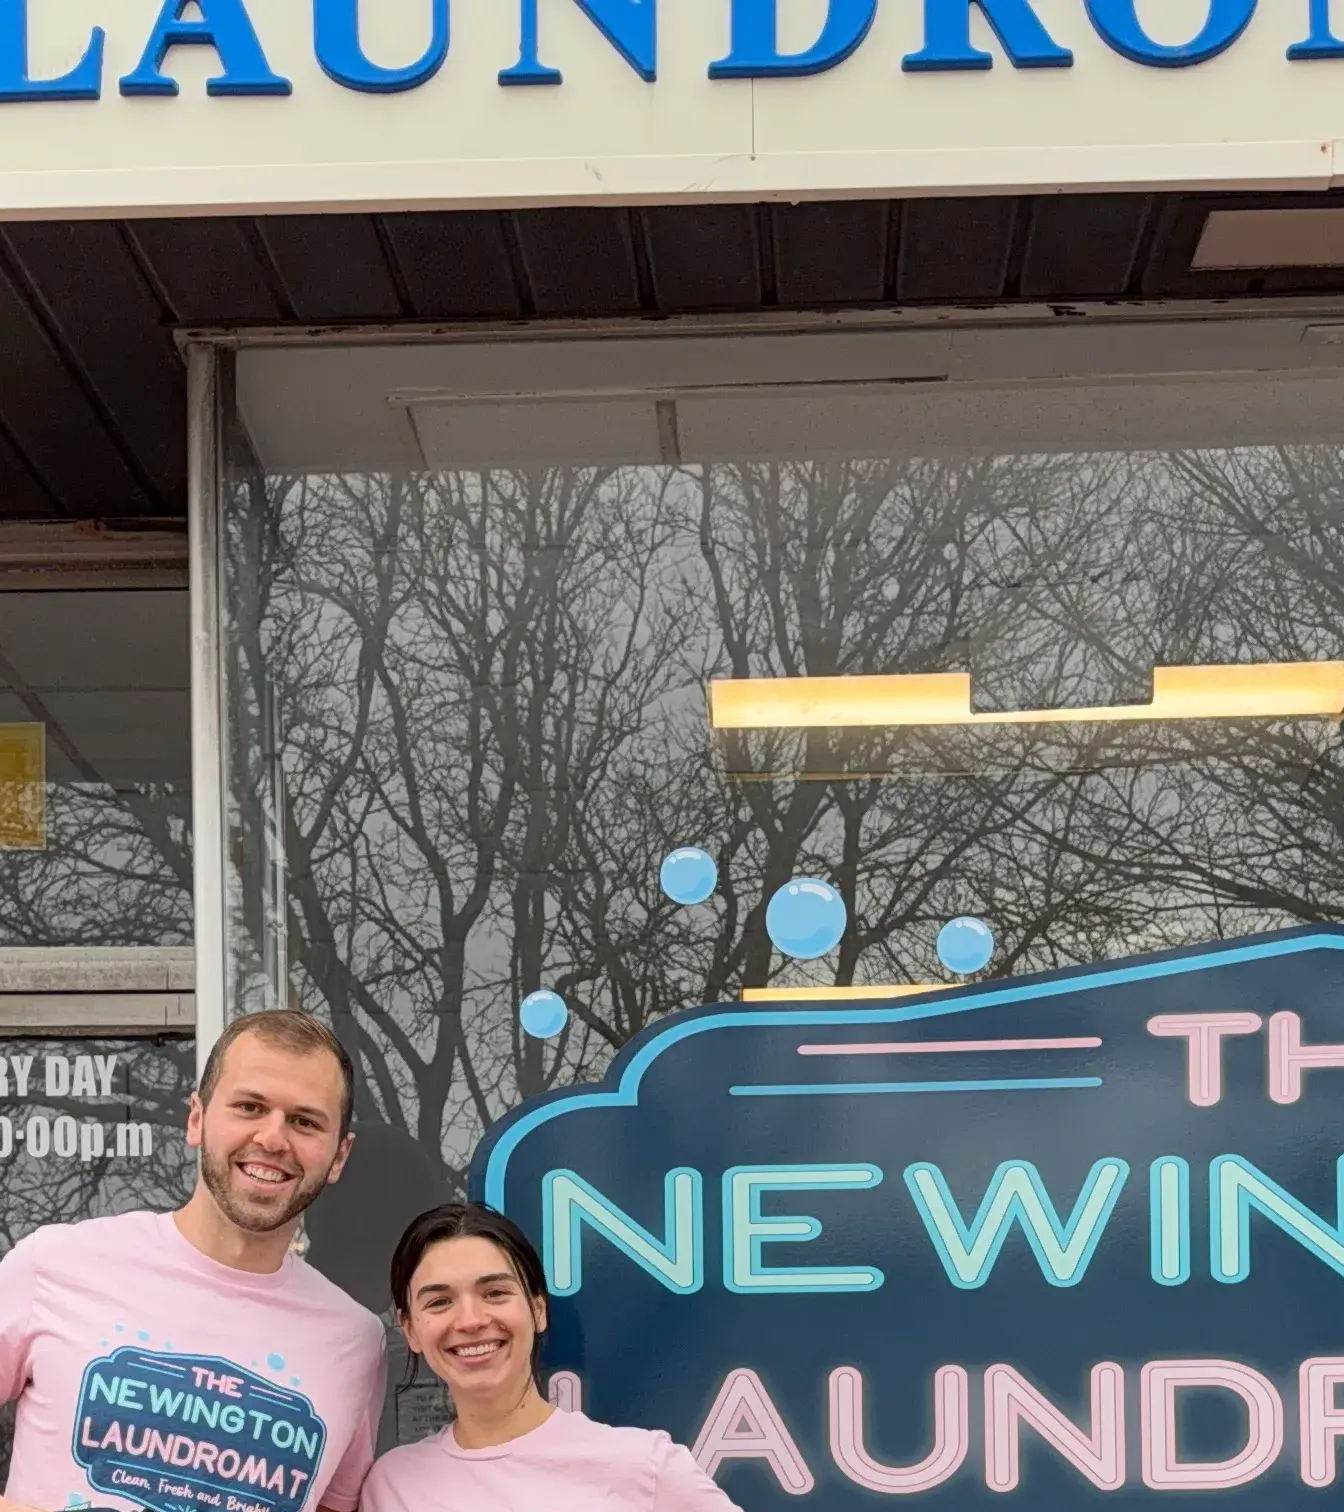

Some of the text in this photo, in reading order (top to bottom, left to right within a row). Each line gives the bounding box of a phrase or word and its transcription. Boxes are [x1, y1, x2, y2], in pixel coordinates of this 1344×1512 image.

[45, 1055, 117, 1096] DAY
[191, 1366, 244, 1398] THE
[89, 1373, 318, 1459] NEWINGTON
[82, 1416, 308, 1499] LAUNDROMAT
[158, 1478, 194, 1498] Fresh
[197, 1492, 221, 1507] and
